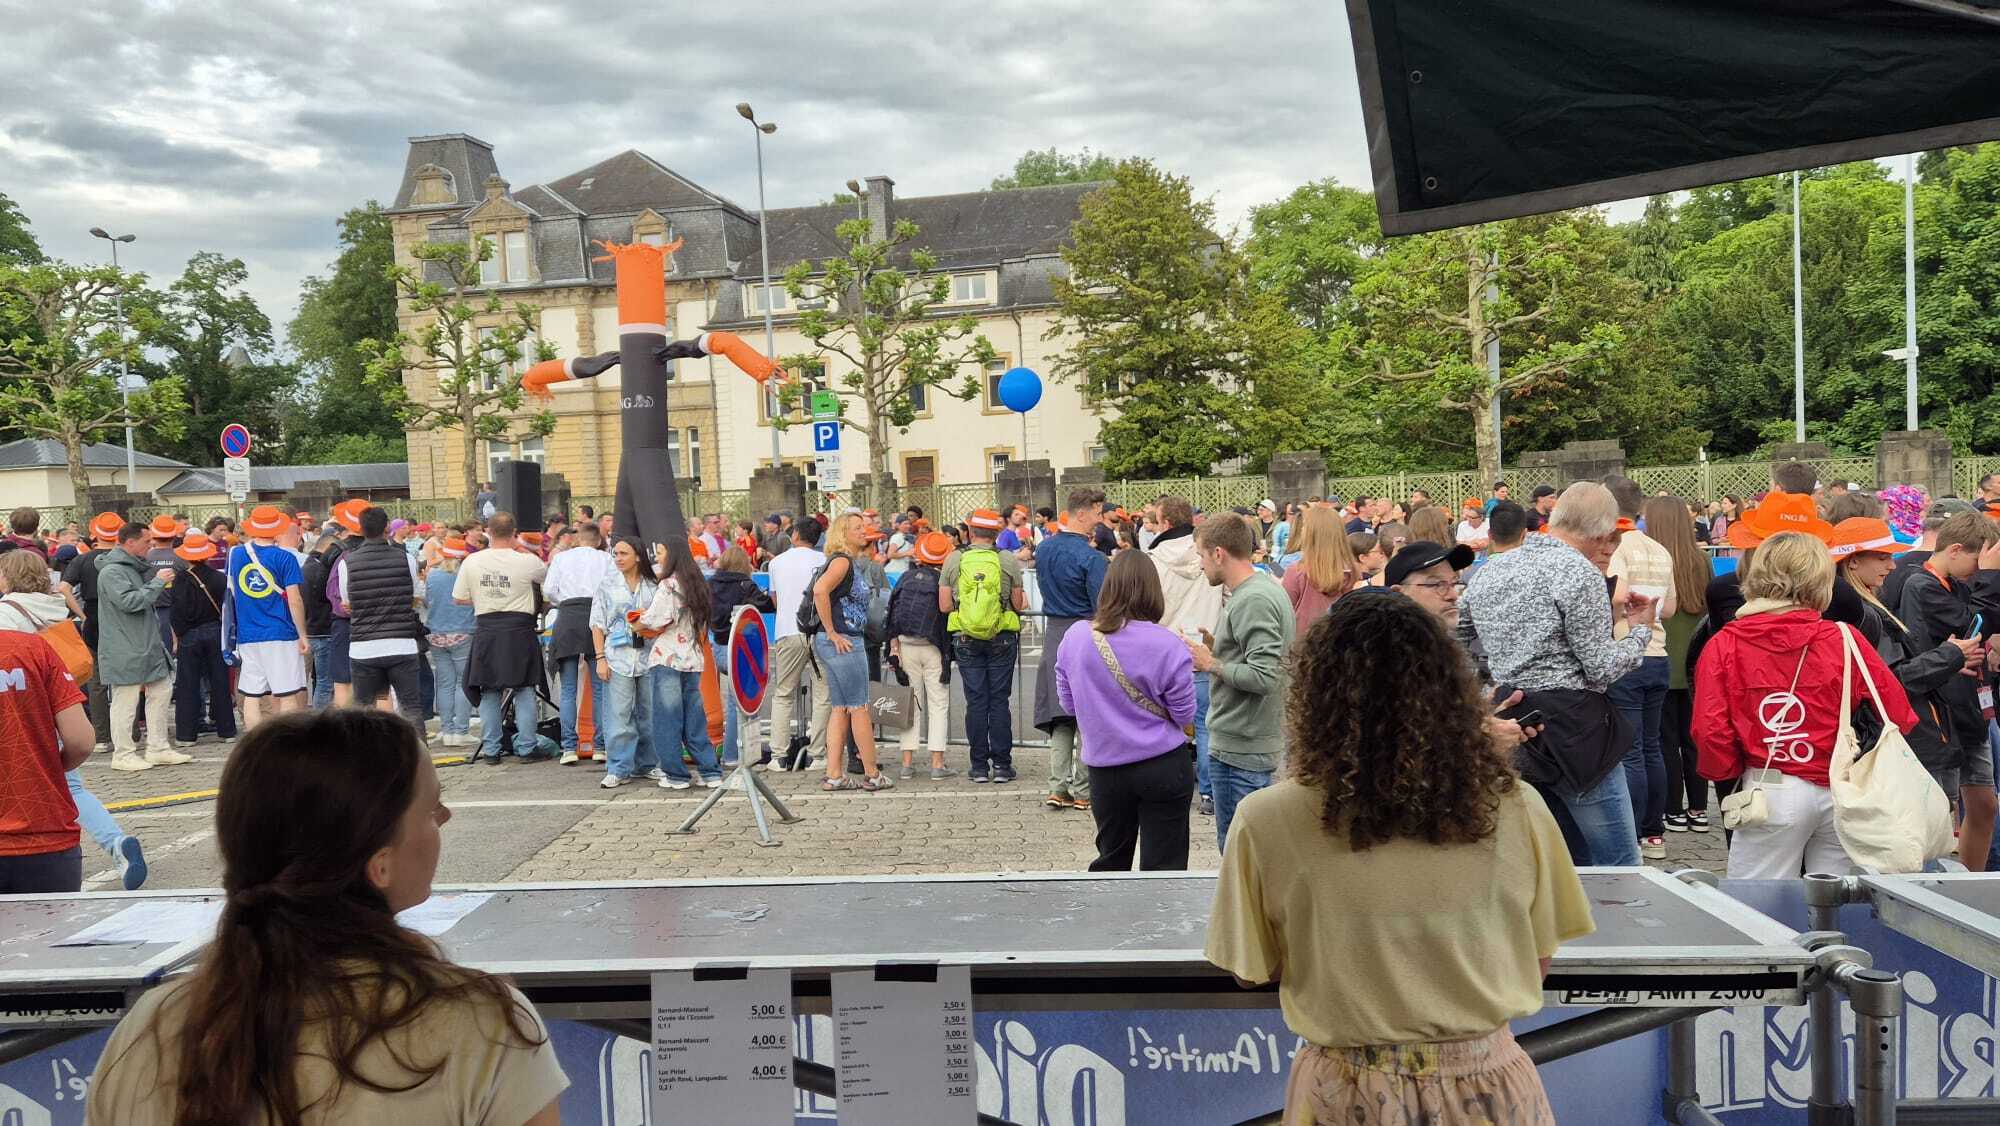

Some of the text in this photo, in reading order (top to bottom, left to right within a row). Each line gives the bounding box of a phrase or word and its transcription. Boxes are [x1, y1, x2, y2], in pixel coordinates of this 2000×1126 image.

[819, 426, 834, 449] P
[751, 1005, 785, 1016] 5,00 €
[944, 1016, 960, 1024] 2,50
[751, 1035, 787, 1046] 4,00 €
[752, 1065, 787, 1076] 4,00 €
[948, 1087, 964, 1095] 2,50
